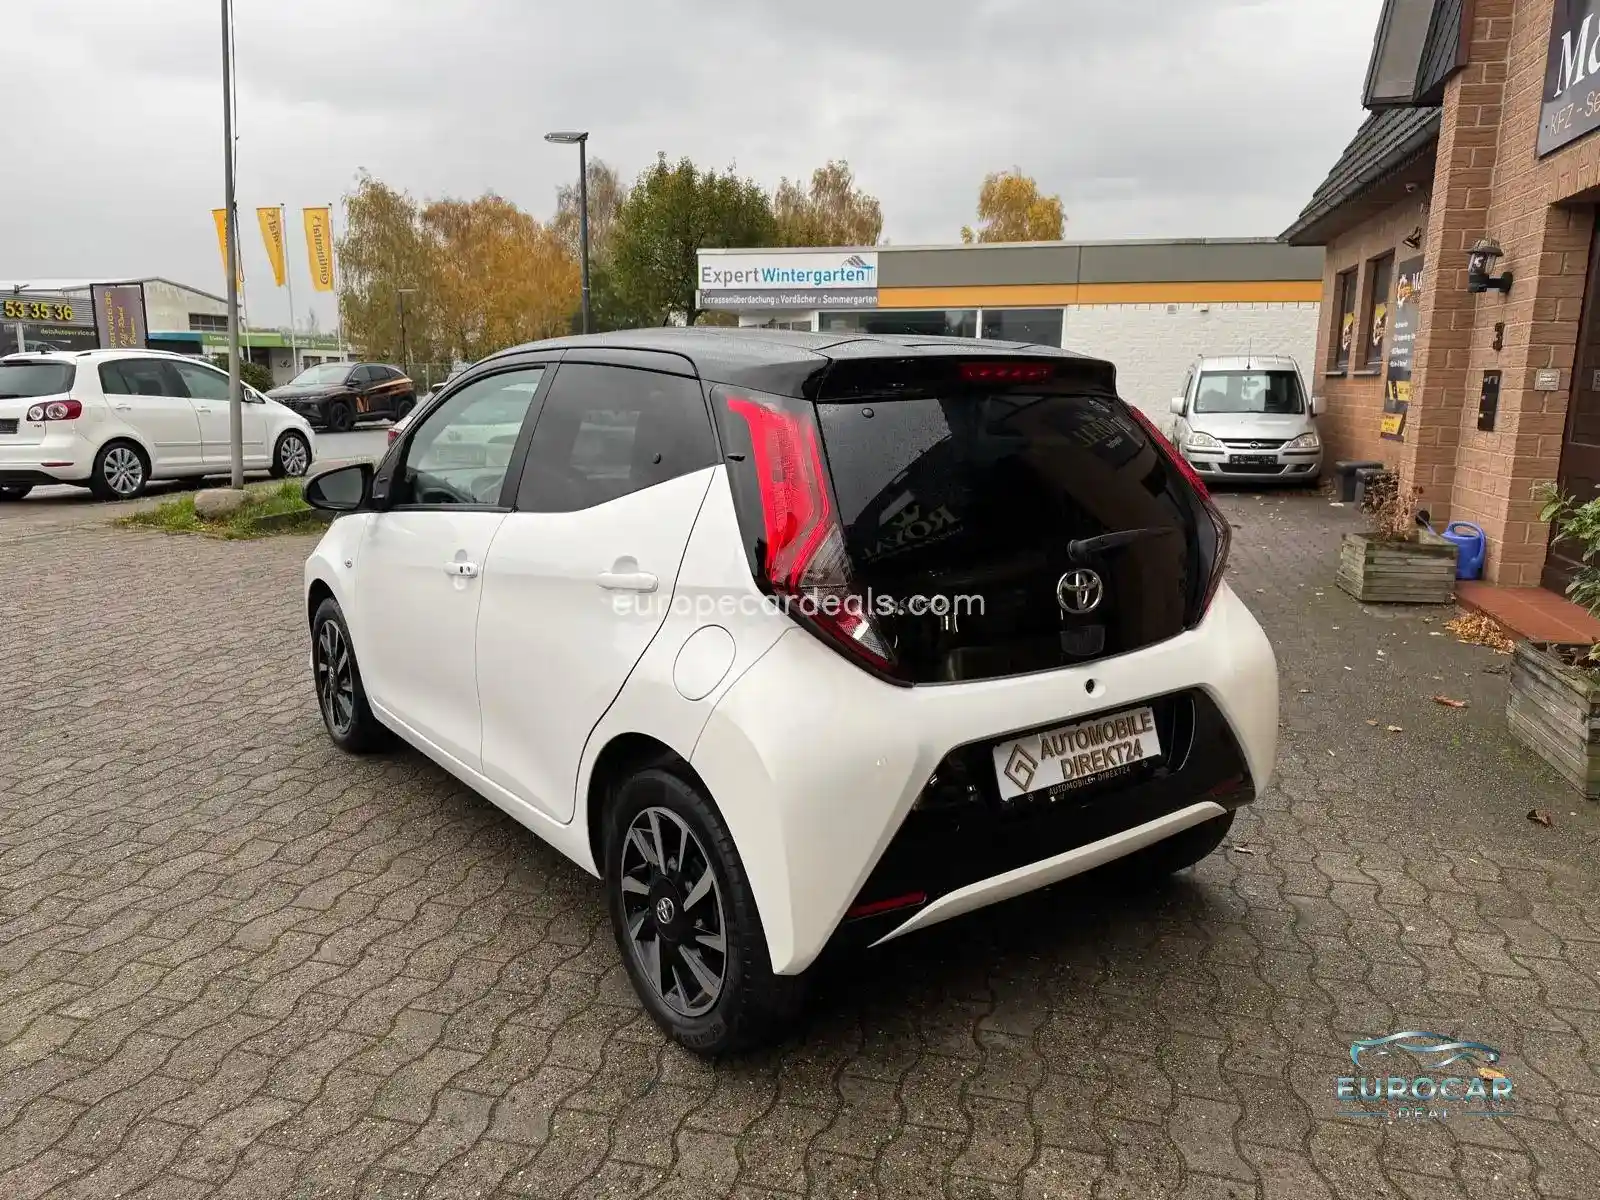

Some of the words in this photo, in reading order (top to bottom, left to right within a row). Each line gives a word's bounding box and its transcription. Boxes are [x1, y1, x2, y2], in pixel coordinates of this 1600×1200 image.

[1550, 102, 1575, 137] KFZ
[701, 266, 760, 287] Expert
[761, 266, 865, 286] Wintergarten
[4, 300, 25, 319] 53
[29, 302, 51, 319] 35
[53, 303, 74, 321] 36
[701, 294, 776, 306] Terrassenüberdachung
[780, 292, 817, 304] Vordächer
[822, 293, 878, 305] Sommergarten
[1040, 711, 1154, 760] AUTOMOBILE
[1060, 738, 1144, 780] DIREKT24
